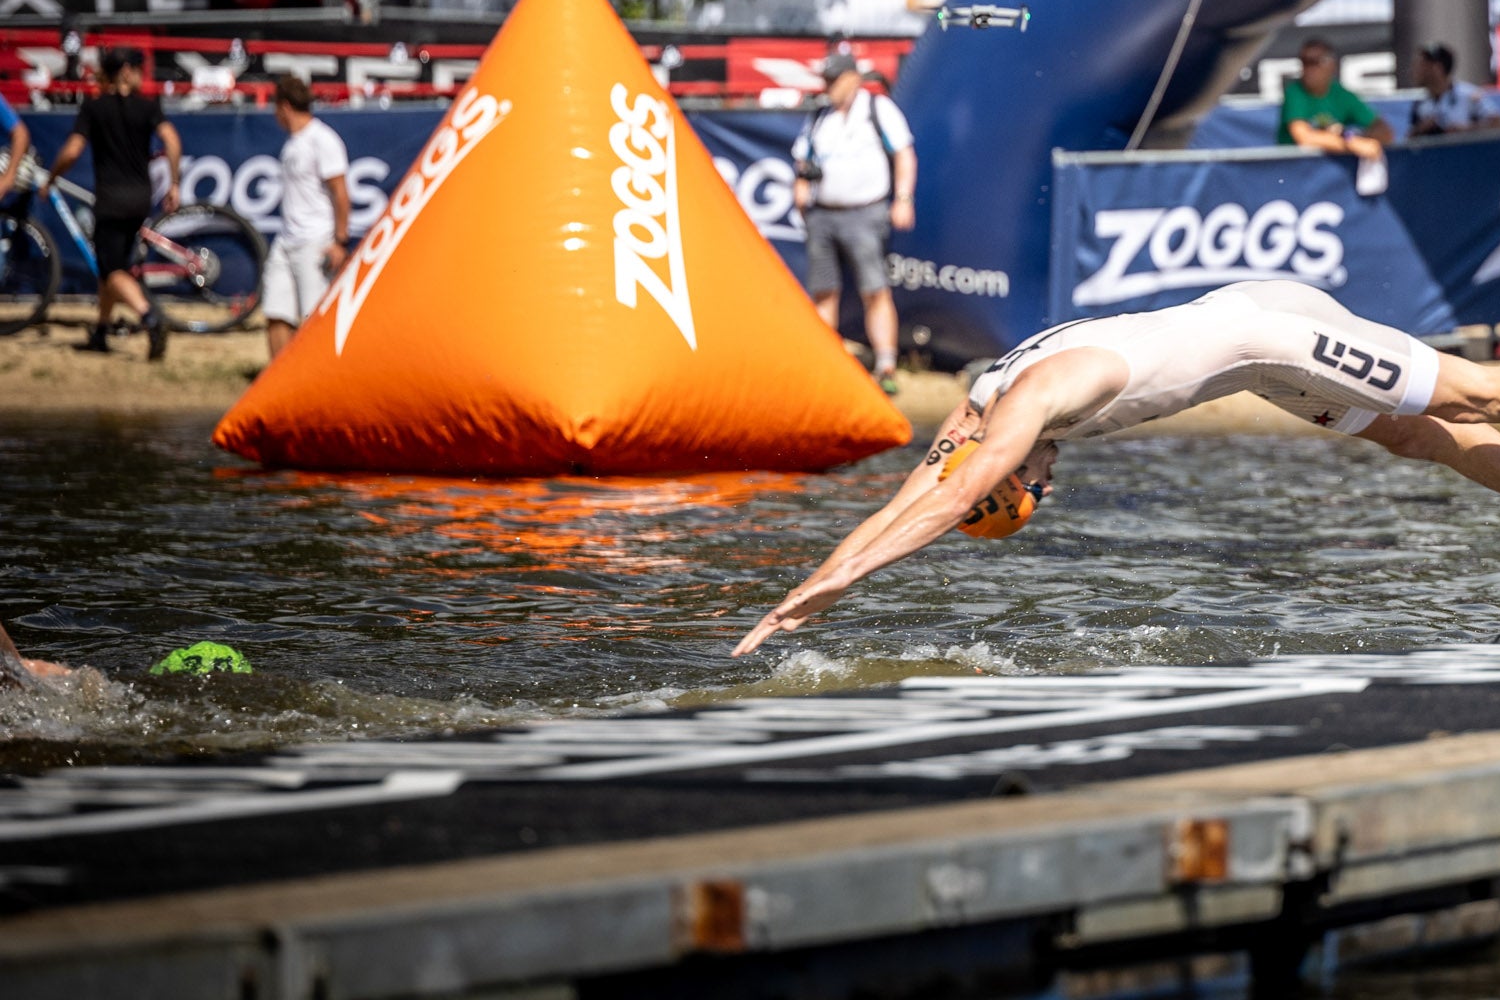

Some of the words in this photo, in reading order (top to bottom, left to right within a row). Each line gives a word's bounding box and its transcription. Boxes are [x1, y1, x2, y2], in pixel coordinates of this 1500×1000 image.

[149, 155, 390, 238] OGS
[319, 87, 508, 356] ZOGGS
[609, 83, 697, 352] ZOGGS
[885, 253, 1010, 298] ggs.com
[1072, 200, 1347, 306] ZOGGS
